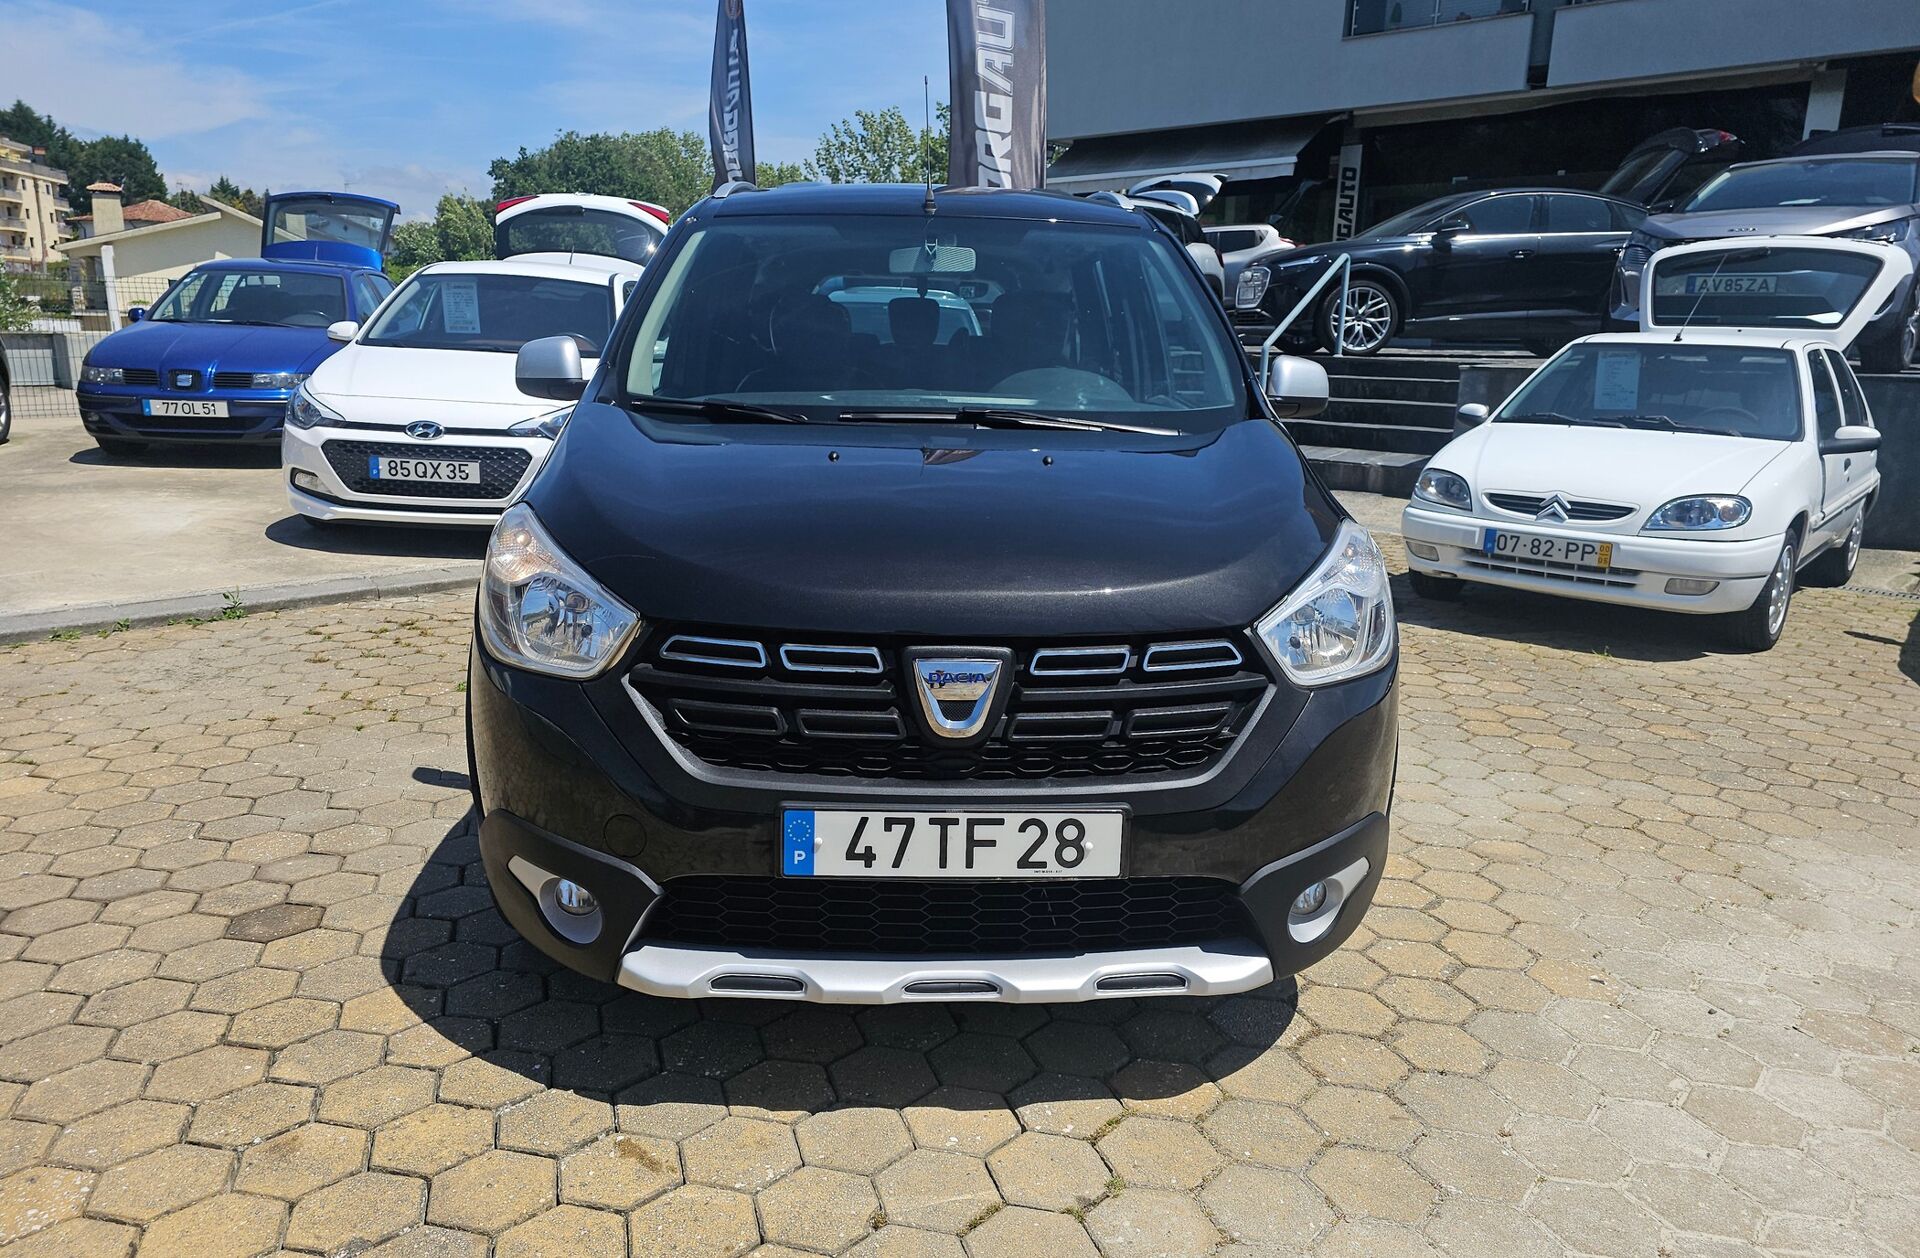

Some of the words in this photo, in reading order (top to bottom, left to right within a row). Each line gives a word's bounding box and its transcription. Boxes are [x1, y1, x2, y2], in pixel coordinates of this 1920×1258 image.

[1697, 278, 1770, 292] AV85ZA
[928, 672, 987, 684] DACIA
[793, 850, 806, 865] P
